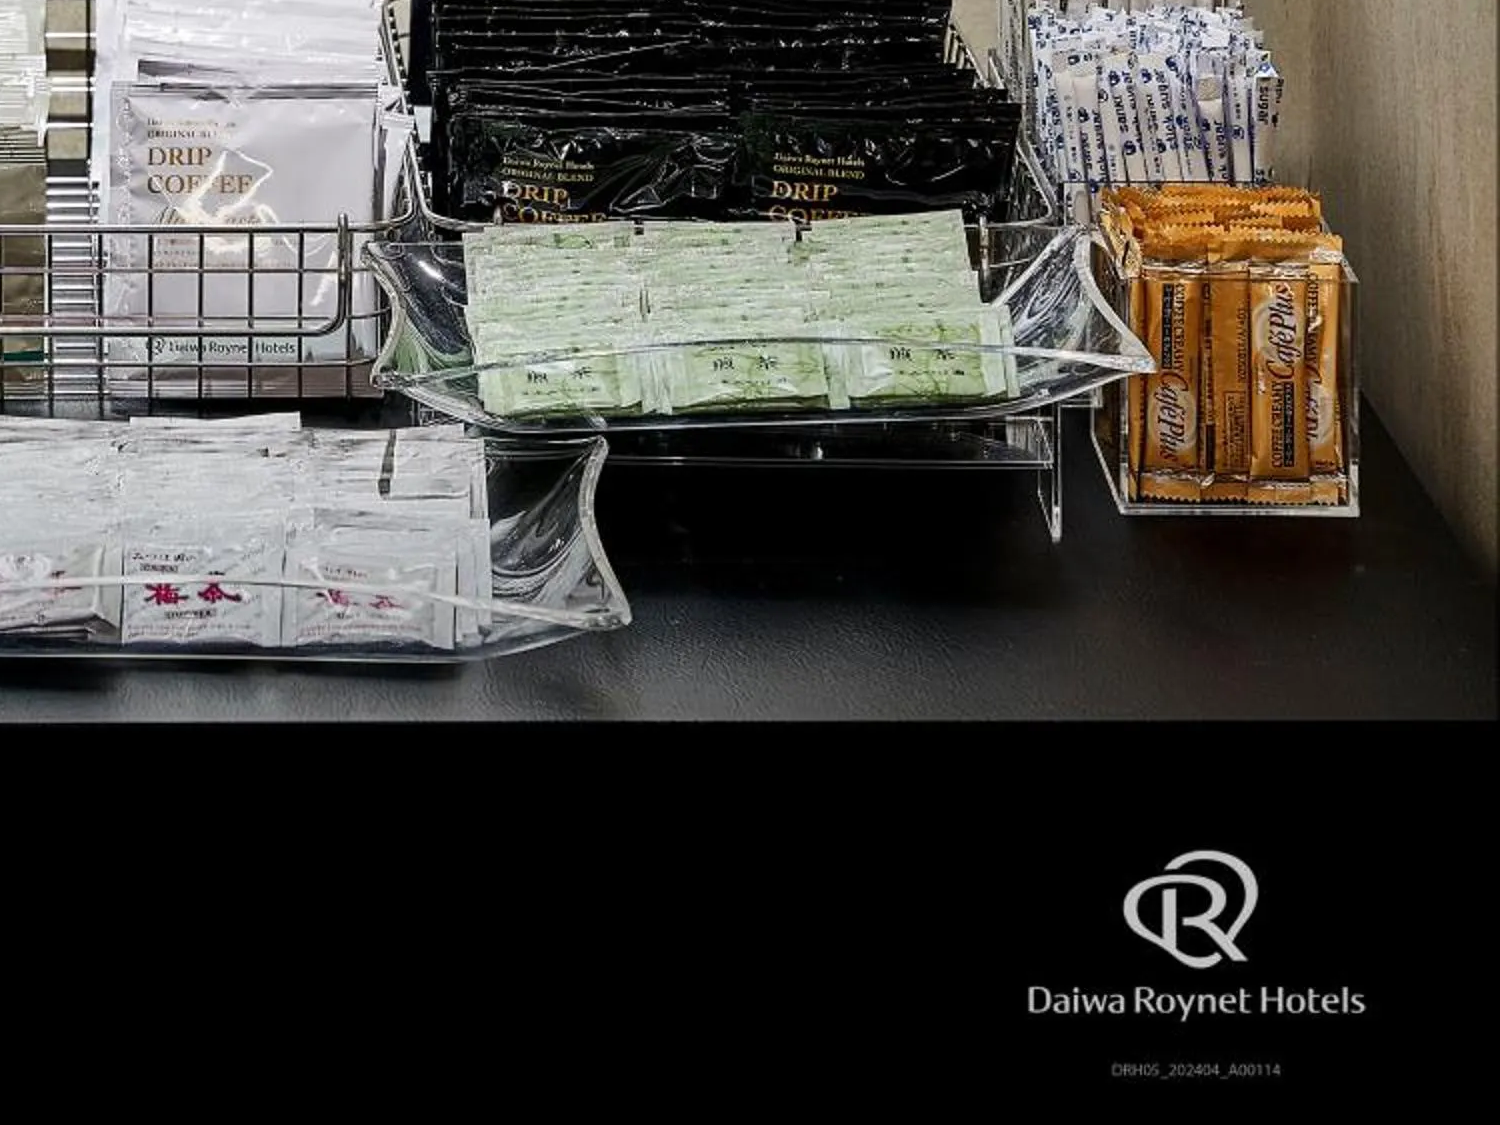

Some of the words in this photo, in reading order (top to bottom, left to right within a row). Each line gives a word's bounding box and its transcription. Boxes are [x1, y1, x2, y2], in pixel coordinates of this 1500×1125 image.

[147, 146, 212, 166] DRIP
[557, 172, 594, 182] BLEND
[773, 165, 824, 176] ORIGINAL
[826, 168, 866, 180] BLEND
[501, 180, 569, 205] DRIP
[771, 180, 839, 202] DRIP
[208, 340, 250, 355] Royne
